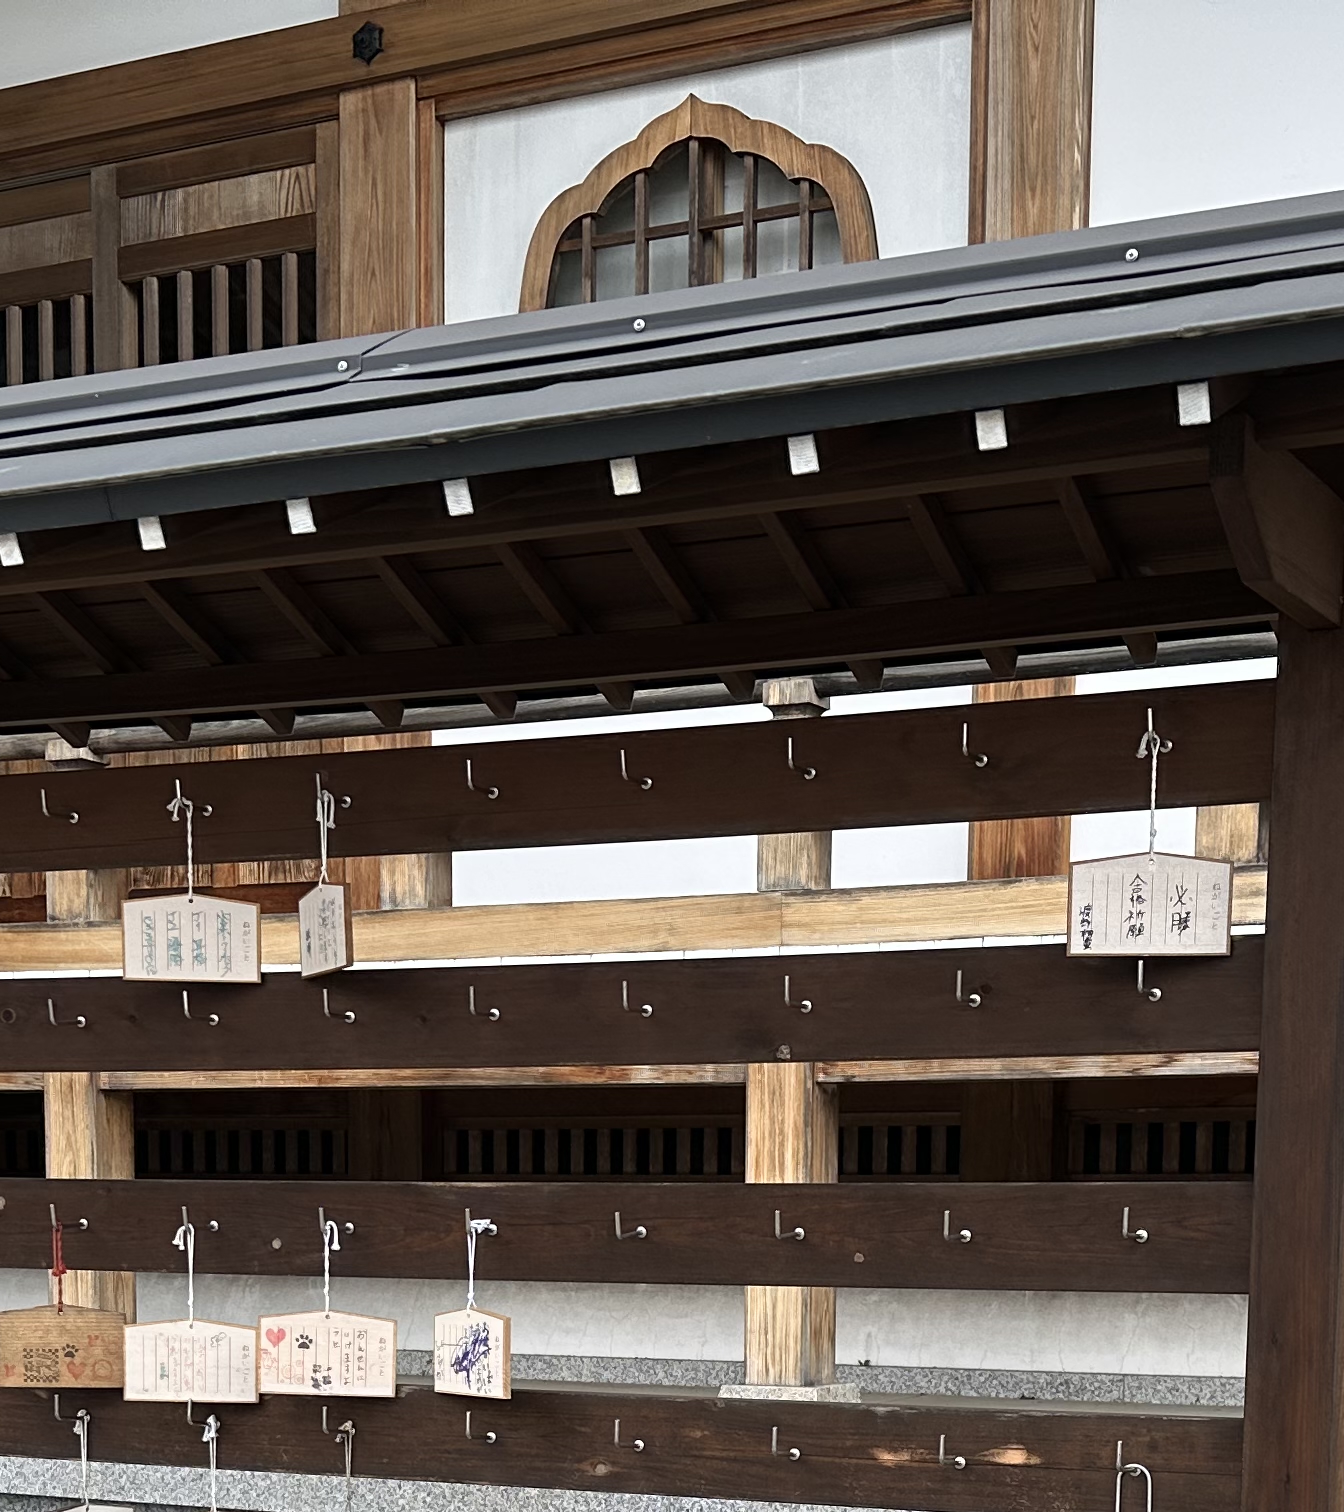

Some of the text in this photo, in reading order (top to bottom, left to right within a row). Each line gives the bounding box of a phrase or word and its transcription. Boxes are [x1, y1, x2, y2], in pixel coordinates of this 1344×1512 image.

[1123, 873, 1148, 939] 合格祈願
[1169, 883, 1193, 936] 必勝
[1210, 882, 1222, 931] ねがいごと
